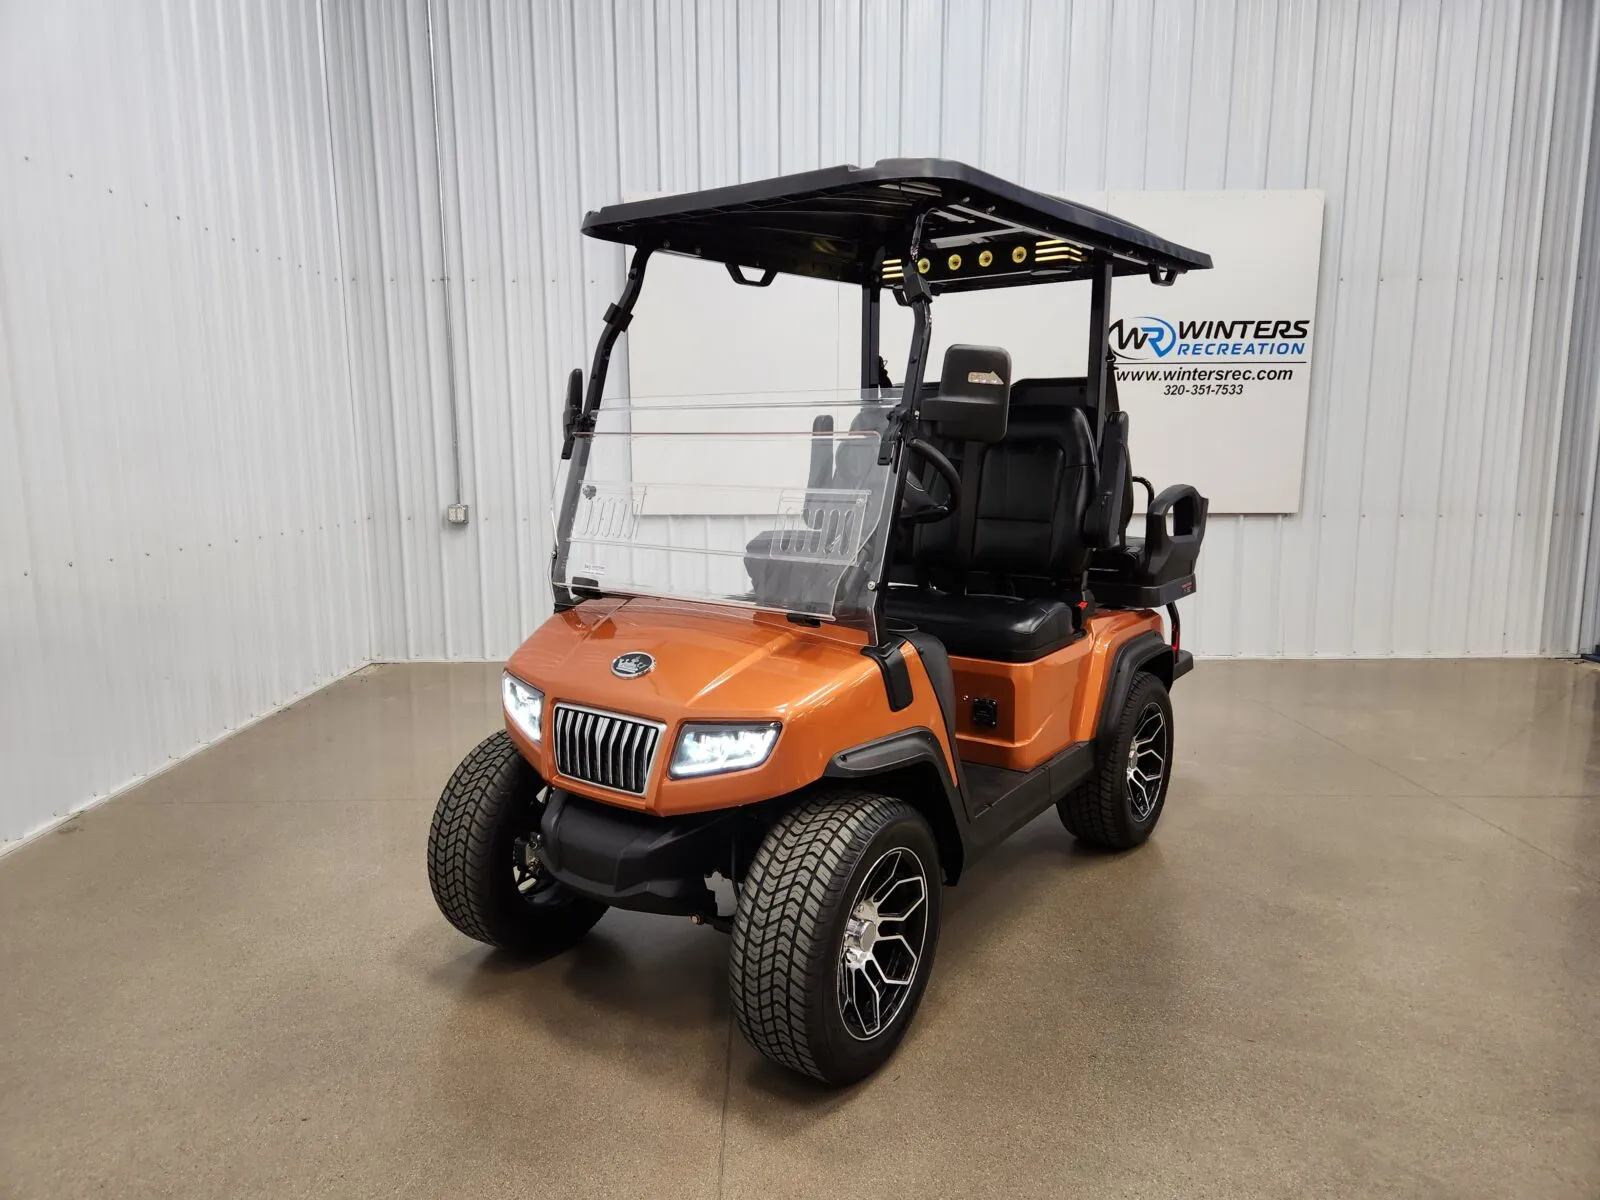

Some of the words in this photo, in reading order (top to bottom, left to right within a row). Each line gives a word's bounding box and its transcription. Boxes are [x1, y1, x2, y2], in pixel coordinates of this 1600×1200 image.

[1179, 320, 1310, 340] WINTERS
[1177, 342, 1305, 356] RECREATION
[1116, 367, 1293, 382] www.wintersrec.com
[1163, 384, 1244, 396] 320-351-7533
